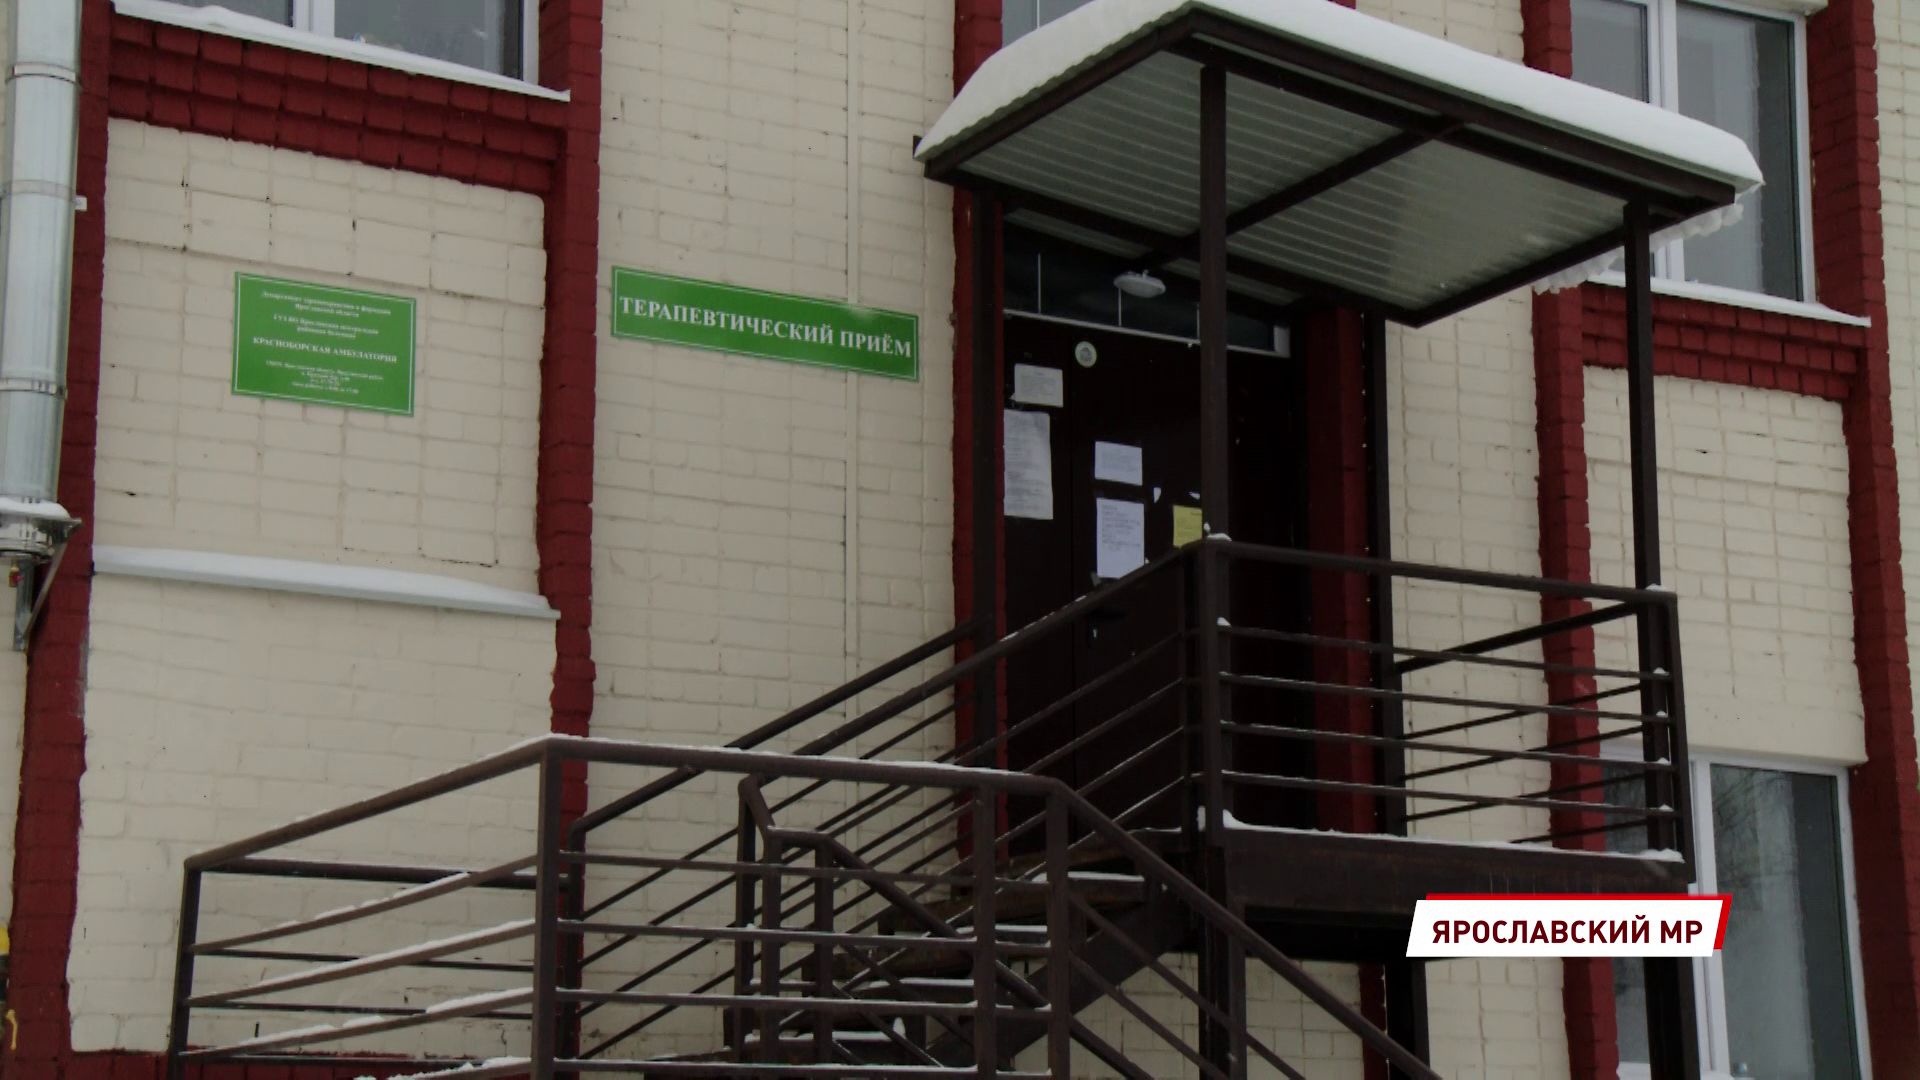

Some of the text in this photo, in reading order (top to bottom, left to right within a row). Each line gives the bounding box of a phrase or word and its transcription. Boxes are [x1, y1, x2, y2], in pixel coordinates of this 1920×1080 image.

[619, 296, 912, 358] ТЕРАПЕВТИЧЕСКИЙ ПРИЁМ
[252, 336, 397, 363] КРАСНОБОРСКАЯ АМБУЛАТОРИЯ
